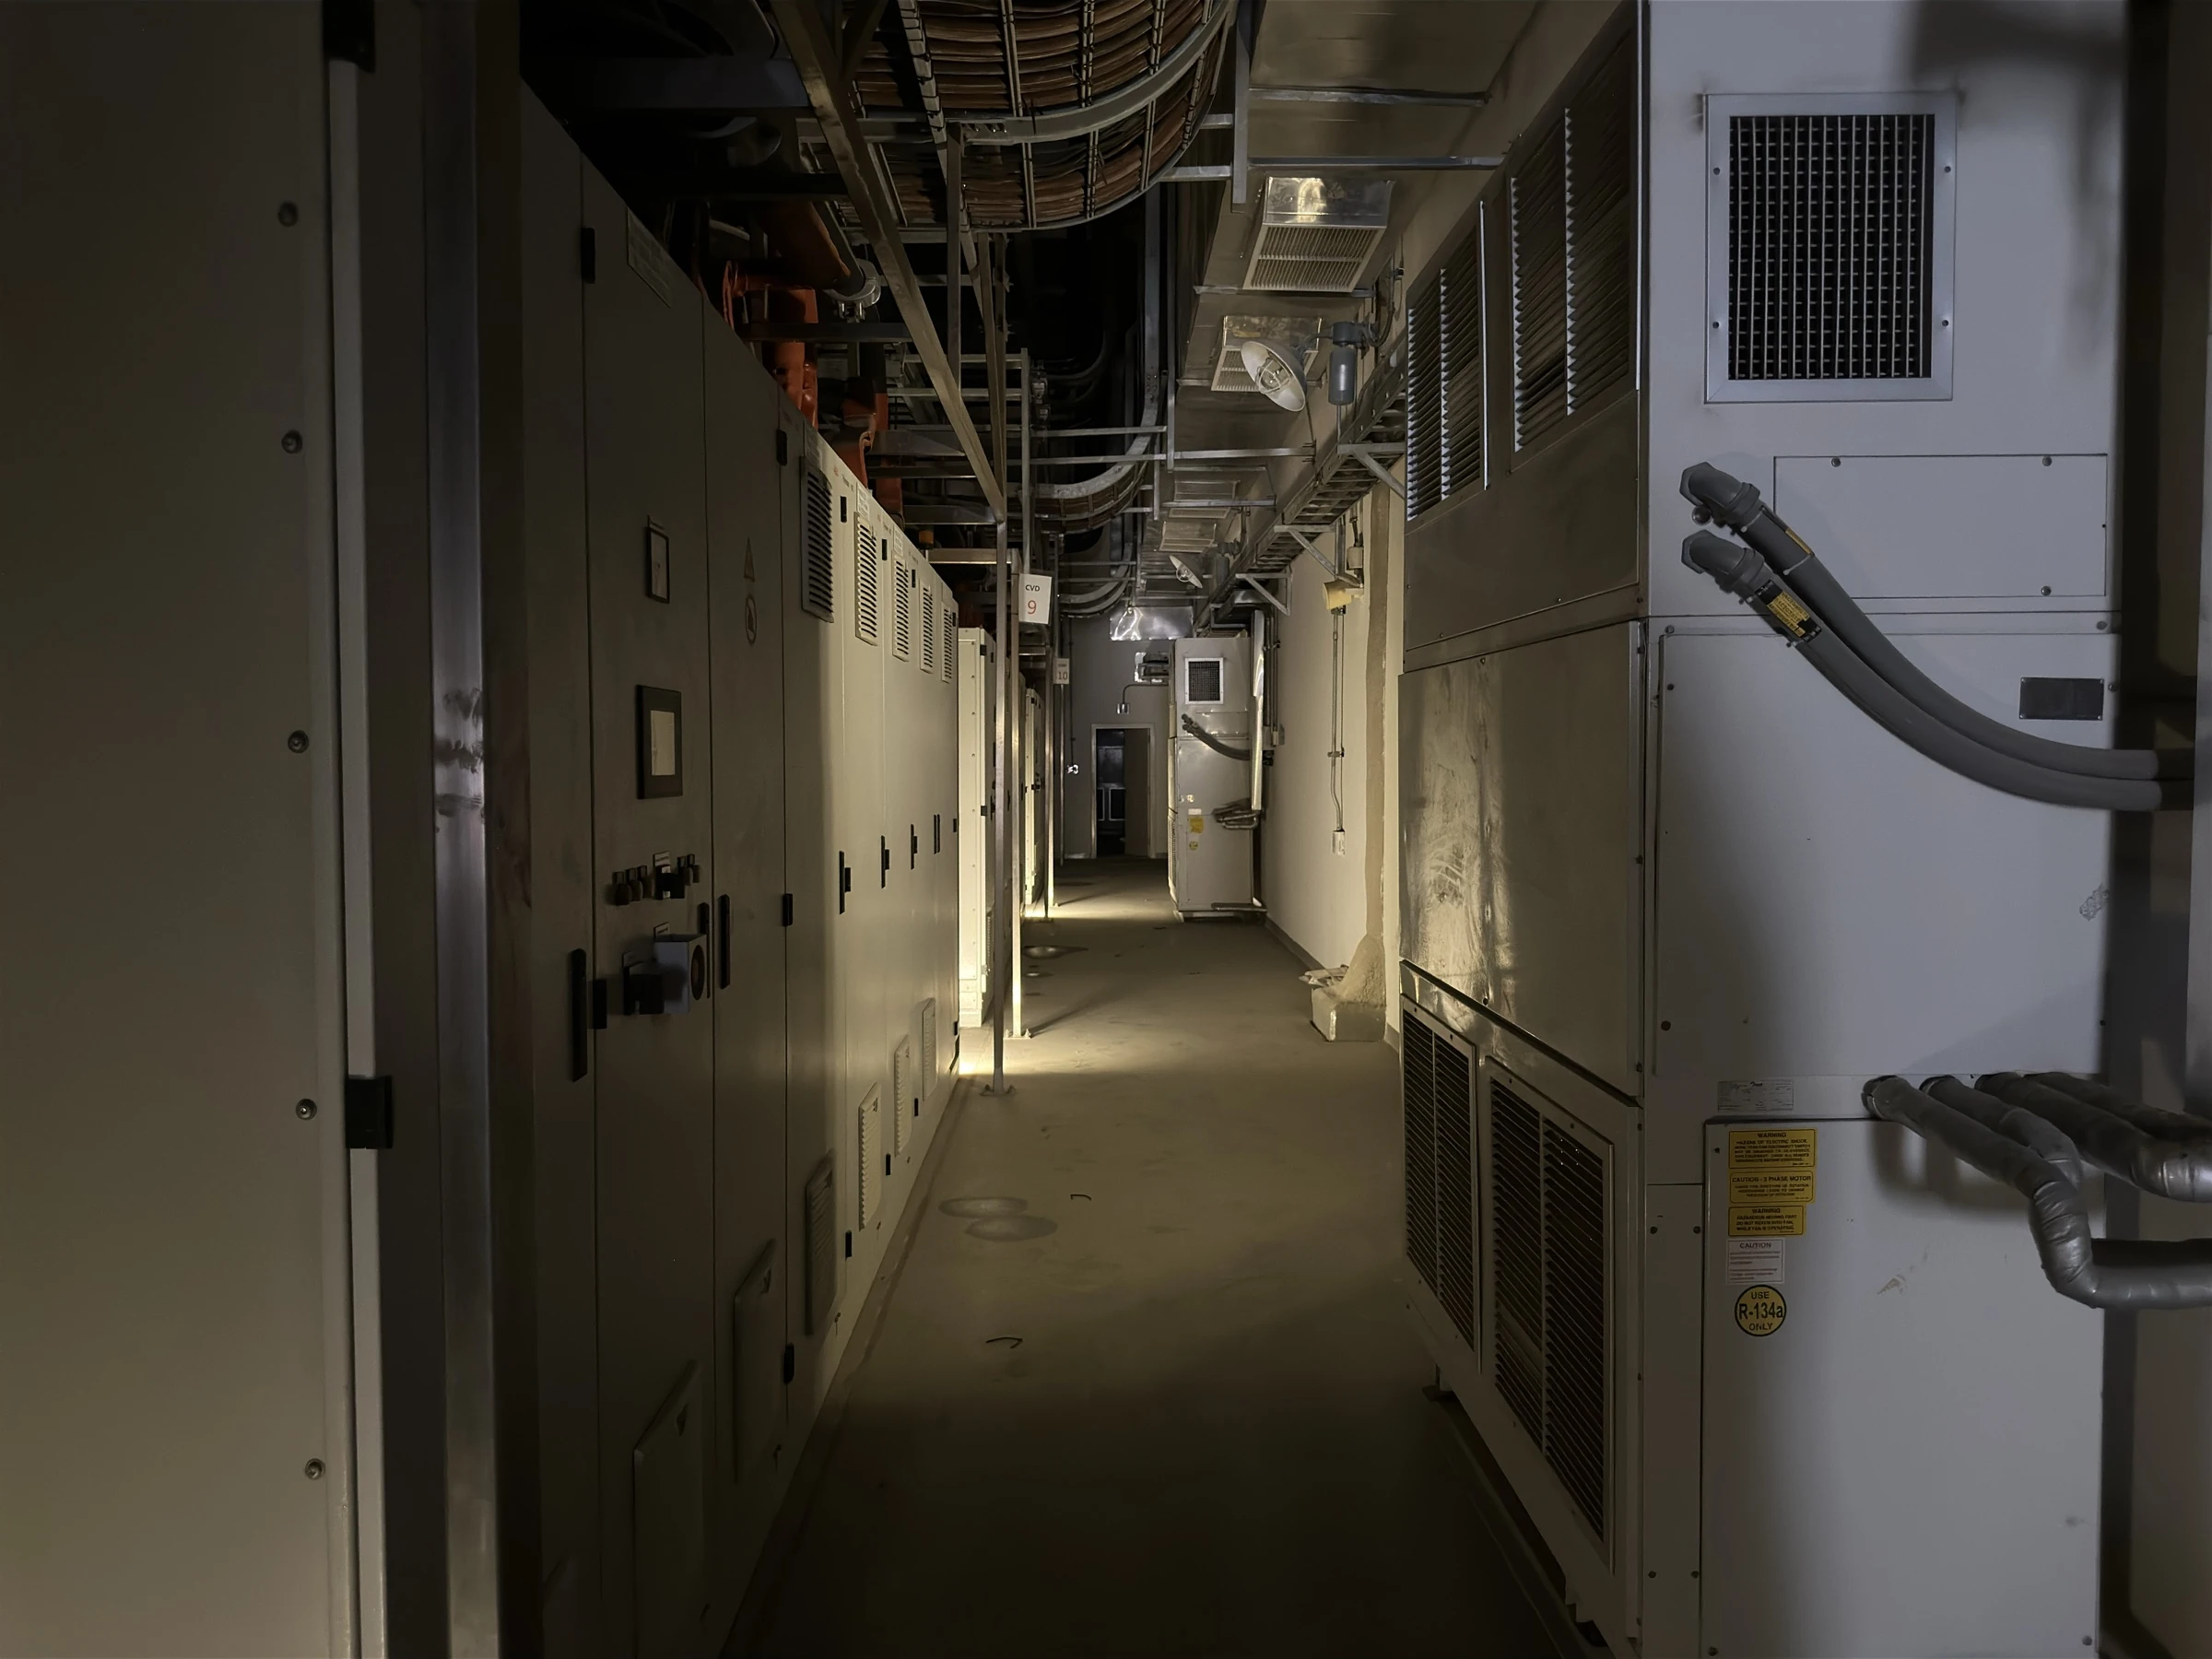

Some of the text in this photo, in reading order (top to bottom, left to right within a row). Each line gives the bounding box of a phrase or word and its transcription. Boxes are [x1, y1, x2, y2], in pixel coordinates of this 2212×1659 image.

[1028, 600, 1037, 615] 9
[1058, 671, 1068, 680] 10
[1750, 1291, 1770, 1300] USE
[1738, 1301, 1783, 1320] R-134a
[1748, 1322, 1773, 1331] ONLY
